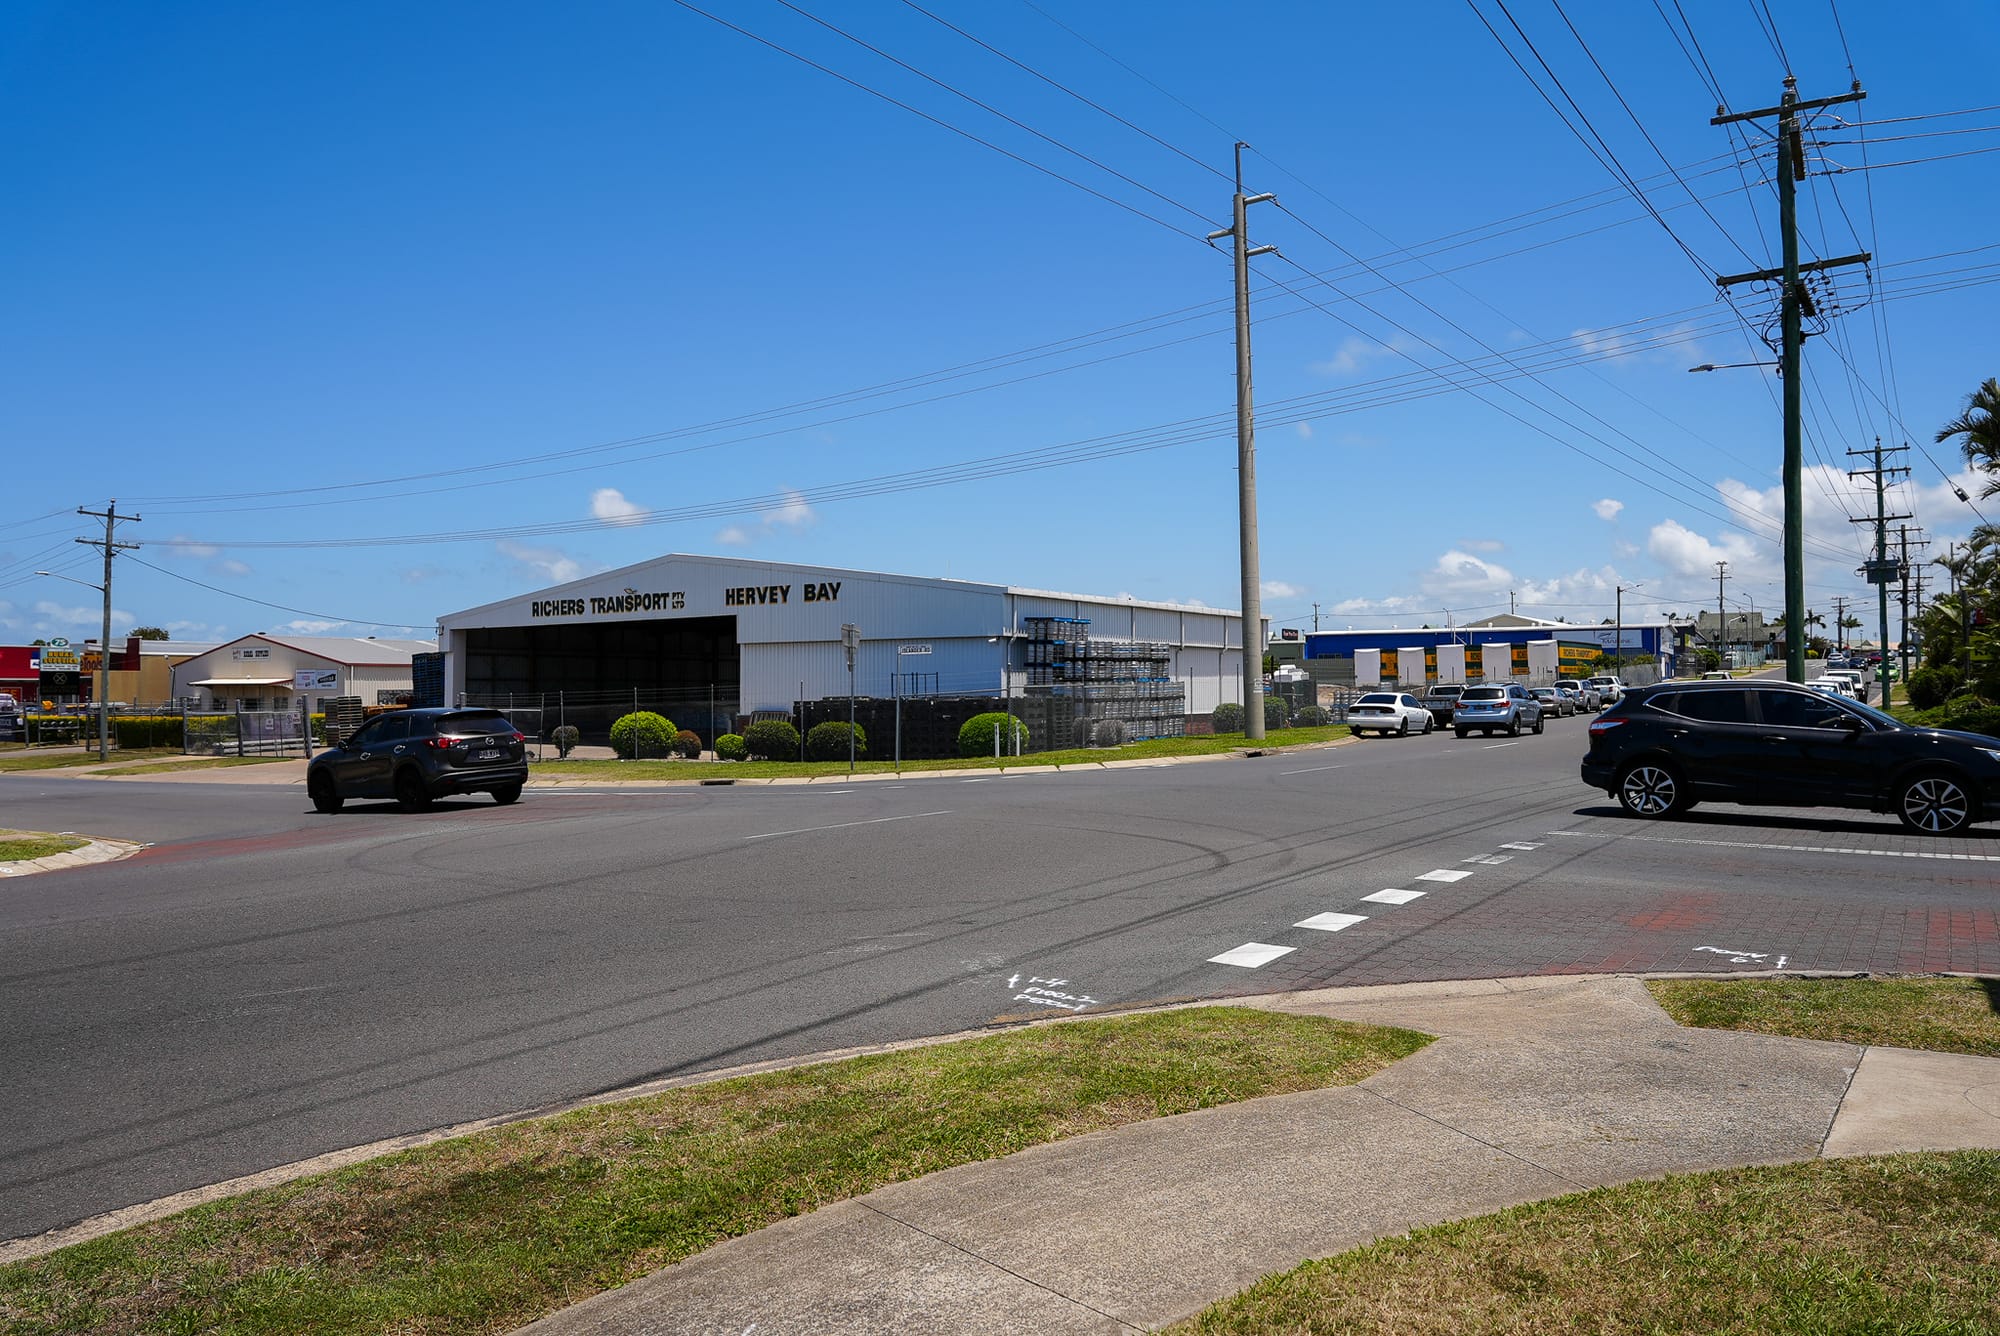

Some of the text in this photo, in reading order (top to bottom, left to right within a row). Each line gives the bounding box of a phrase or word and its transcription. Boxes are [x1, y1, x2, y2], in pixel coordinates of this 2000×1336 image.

[672, 592, 685, 600] PTY
[725, 581, 842, 606] HERVEY BAY
[532, 592, 669, 617] RICHERS TRANSPORT
[672, 600, 685, 609] LTD
